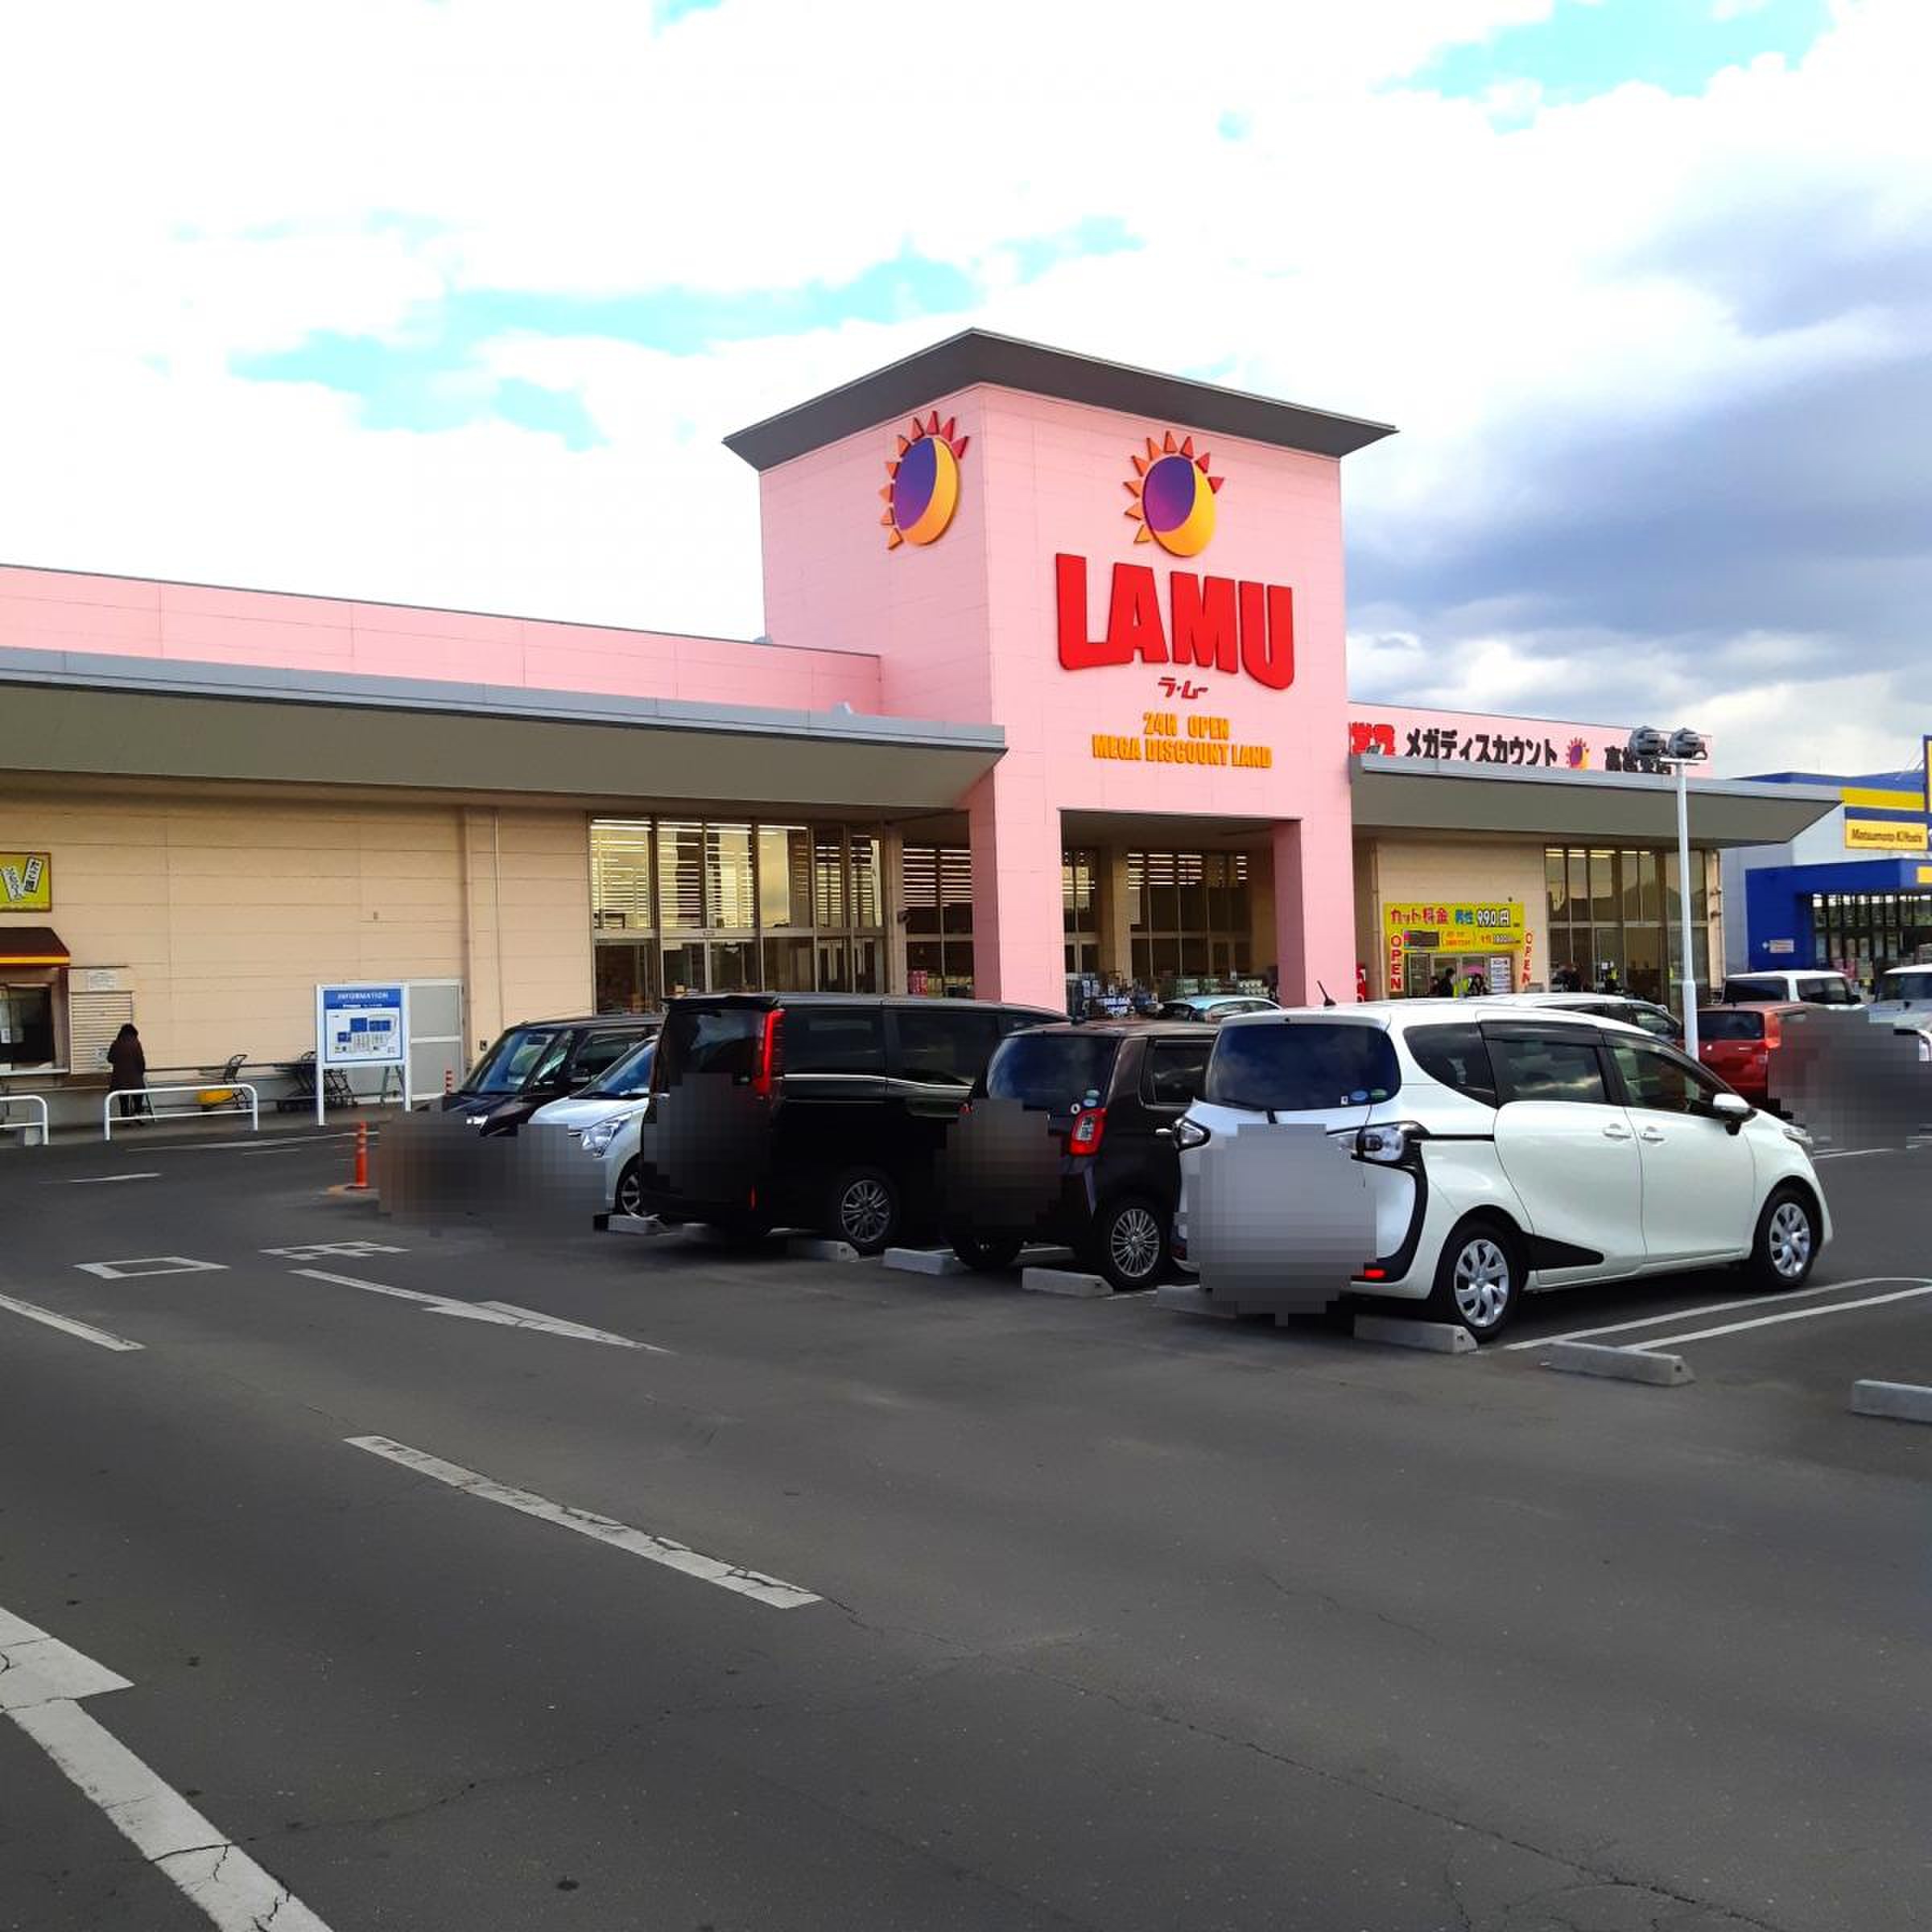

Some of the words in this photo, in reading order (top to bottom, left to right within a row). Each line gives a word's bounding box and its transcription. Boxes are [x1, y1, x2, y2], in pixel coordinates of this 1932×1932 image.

[1055, 552, 1295, 690] LAMU
[1142, 712, 1178, 736] 24H
[1187, 715, 1229, 740] OPEN
[1092, 734, 1141, 760] MEGA
[1146, 738, 1229, 765] DISCOUNT
[1231, 745, 1273, 768] LAND
[1405, 728, 1558, 766] メガディスカウント
[1390, 935, 1402, 989] OPEN
